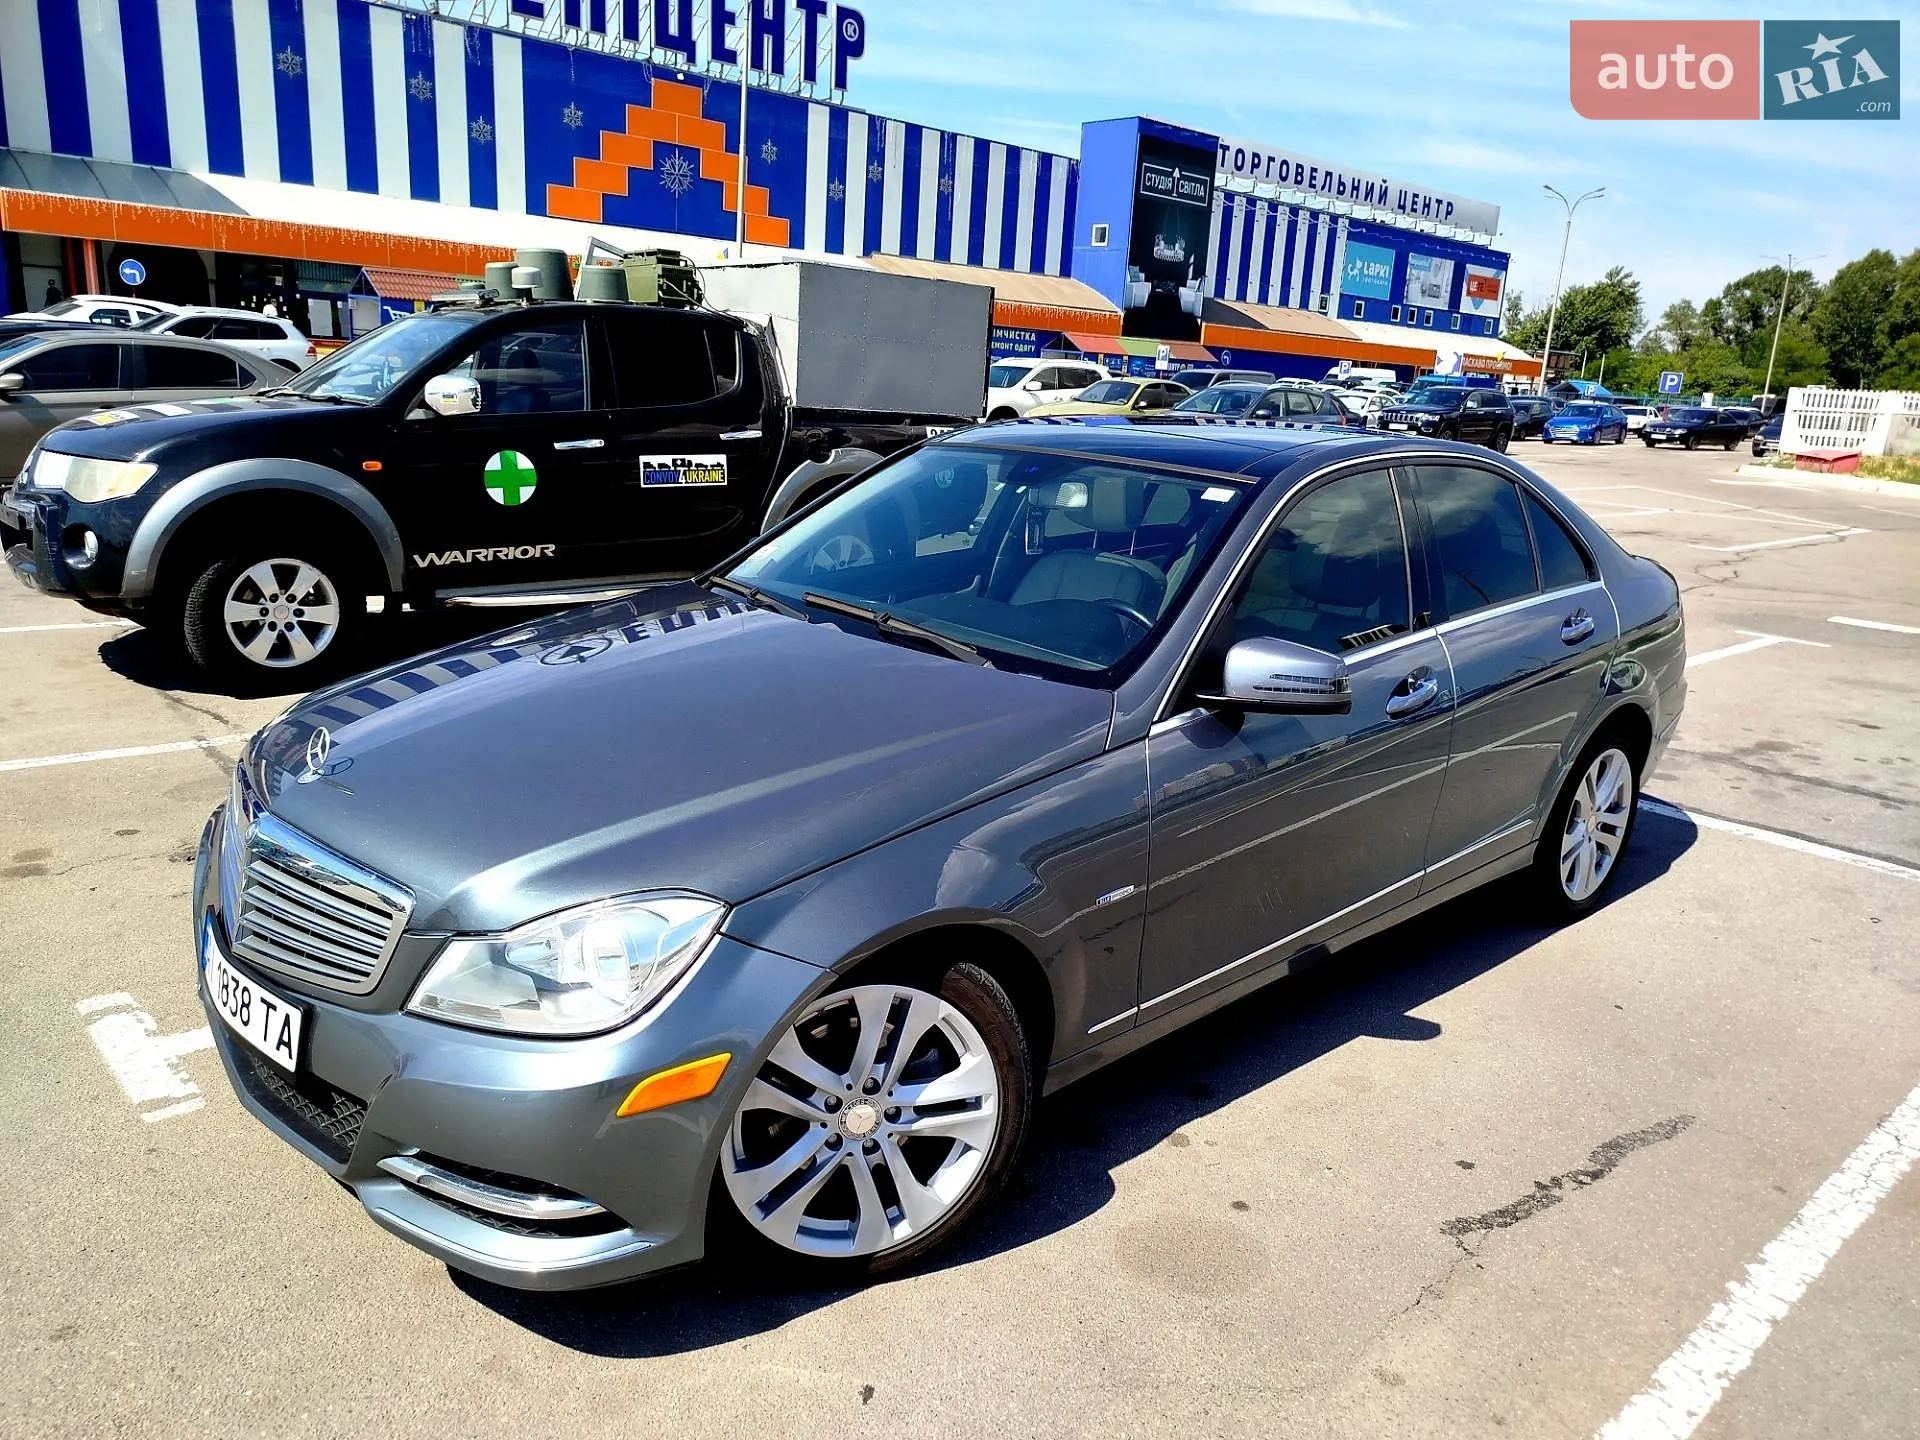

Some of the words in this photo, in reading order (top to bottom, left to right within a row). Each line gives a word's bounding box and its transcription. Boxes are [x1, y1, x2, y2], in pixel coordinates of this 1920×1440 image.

[510, 0, 865, 91] ІЦЕНТР
[1145, 172, 1173, 191] СТУДІЯ
[1178, 179, 1205, 198] СВІТЛА
[1219, 143, 1390, 207] ТОРГОВЕЛЬНИЙ
[1397, 188, 1455, 220] ЦЕНТР
[990, 341, 1014, 351] ЕМОНТ
[993, 328, 1036, 342] ІМЧИСТКА
[1665, 375, 1679, 391] P
[412, 543, 556, 568] WARRIOR
[217, 960, 251, 1028] 1838
[260, 996, 293, 1061] TA
